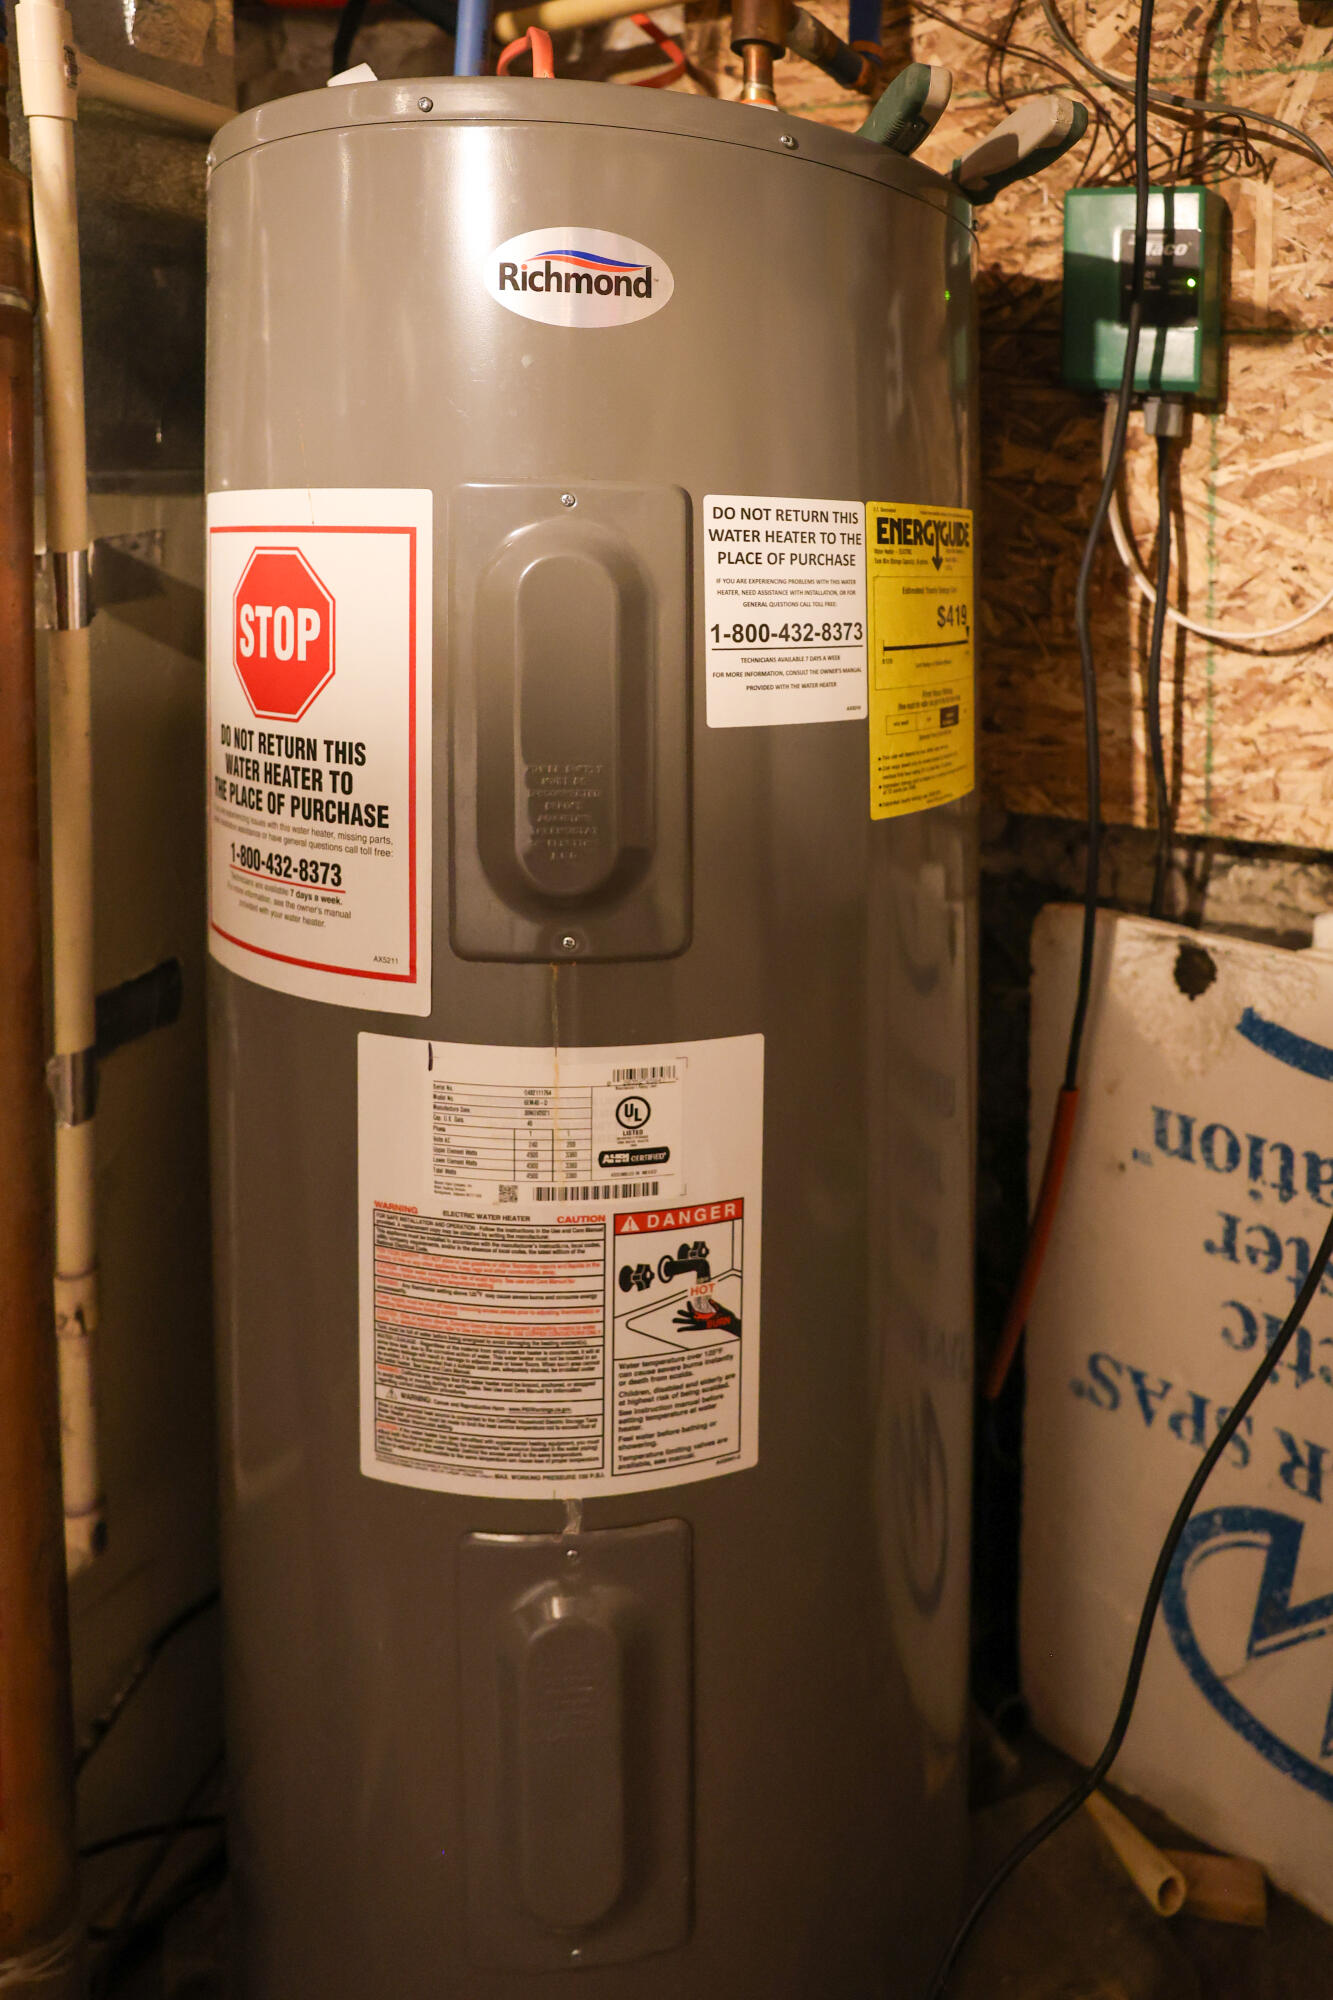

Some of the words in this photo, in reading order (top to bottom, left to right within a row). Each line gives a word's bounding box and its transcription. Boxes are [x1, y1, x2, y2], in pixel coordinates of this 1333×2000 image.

[499, 260, 652, 298] Richmond
[712, 507, 736, 520] DO
[740, 507, 771, 522] NOT
[776, 509, 829, 523] RETURN
[833, 511, 859, 524] THIS
[709, 529, 760, 542] WATER
[765, 530, 815, 544] HEATER
[820, 532, 836, 544] TO
[840, 533, 862, 545] THE
[876, 517, 970, 548] ENERGYGUIDE
[718, 551, 762, 565] PLACE
[767, 552, 785, 565] OF
[790, 553, 856, 566] PURCHASE
[240, 604, 320, 662] STOP
[710, 622, 863, 643] 1-800-432-8373
[221, 724, 231, 746] DO
[234, 728, 254, 752] NOT
[258, 732, 317, 761] RETURN
[324, 739, 366, 767] THIS
[225, 753, 259, 782] WATER
[264, 762, 322, 792] HEATER
[329, 770, 353, 795] TO
[215, 776, 226, 801] THE
[230, 783, 262, 812] PLACE
[268, 791, 284, 815] OF
[291, 796, 389, 828] PURCHASE
[292, 826, 310, 835] water
[311, 827, 335, 840] heater,
[338, 832, 367, 844] missing
[369, 836, 393, 845] parts,
[283, 838, 306, 846] general
[308, 841, 343, 852] questions
[360, 847, 372, 855] toll
[230, 842, 342, 887] 1-800-432-8373
[296, 890, 312, 902] days
[321, 896, 342, 905] week.
[285, 900, 295, 909] the
[297, 904, 322, 915] owner's
[324, 909, 351, 919] manual
[624, 1103, 642, 1122] UL
[1150, 1103, 1333, 1207] ation
[374, 1200, 418, 1214] WARNING
[442, 1210, 475, 1220] ELECTRIC
[476, 1213, 501, 1221] WATER
[647, 1203, 736, 1228] DANGER
[557, 1215, 606, 1224] CAUTION
[690, 1283, 715, 1297] HOT
[1273, 1425, 1330, 1503] R
